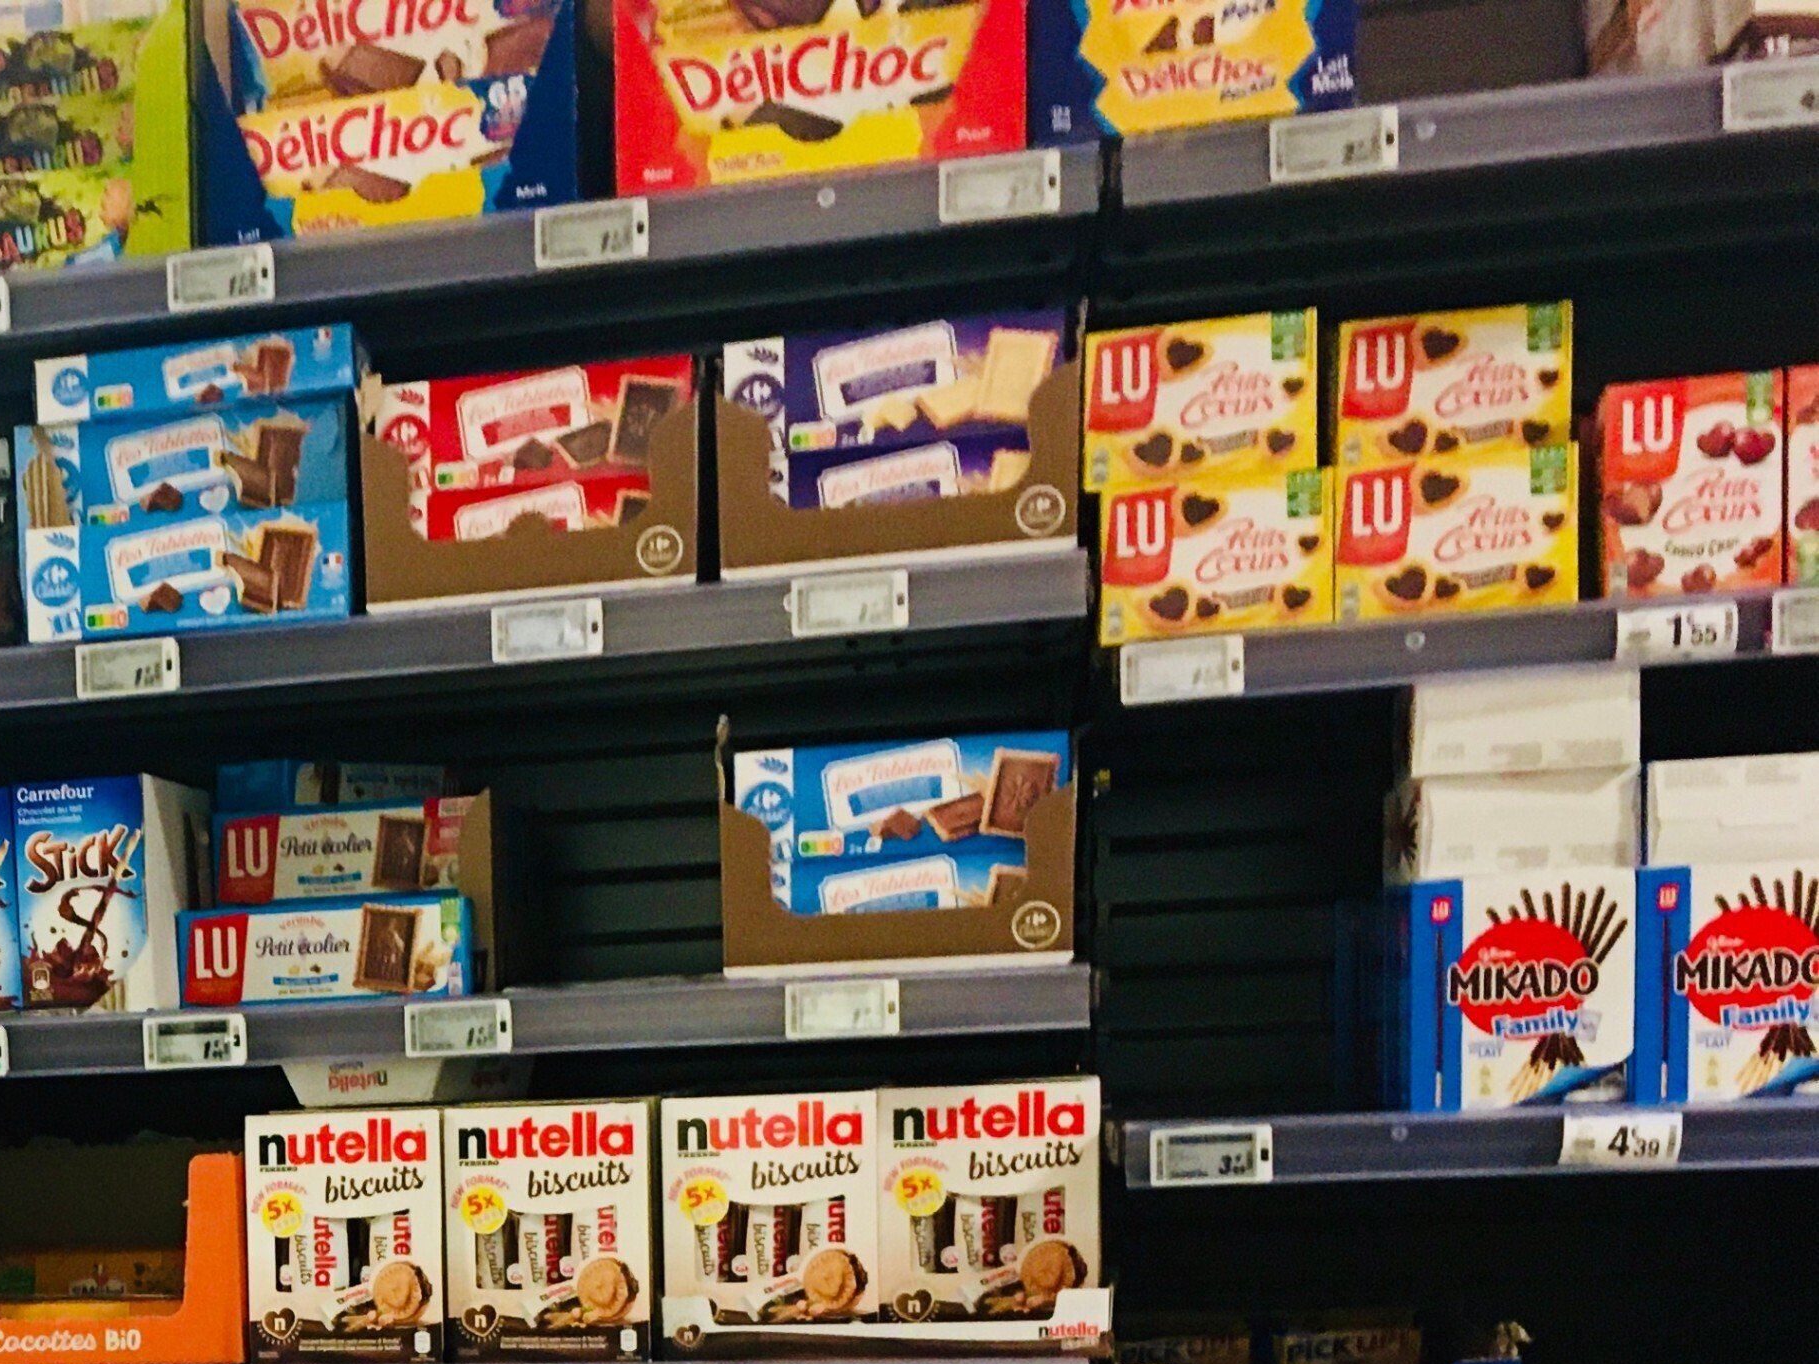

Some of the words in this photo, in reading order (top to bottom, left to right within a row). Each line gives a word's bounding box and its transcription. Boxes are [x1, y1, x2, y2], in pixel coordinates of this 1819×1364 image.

[671, 33, 947, 111] DéliChoc
[17, 785, 94, 803] Carrefour
[227, 827, 269, 878] LU
[281, 836, 319, 858] Petit
[321, 833, 372, 858] écolier
[195, 926, 238, 978] LU
[1449, 960, 1599, 1005] MIKADO
[1494, 1011, 1579, 1038] Family
[1721, 1004, 1809, 1030] Family
[459, 1111, 633, 1158] nutella
[677, 1100, 863, 1151] nutella
[893, 1091, 1085, 1141] nutella
[259, 1117, 426, 1165] nutella
[969, 1142, 1083, 1181] biscuits
[325, 1167, 424, 1204] biscuits
[527, 1160, 631, 1199] biscuits
[751, 1152, 861, 1191] biscuits
